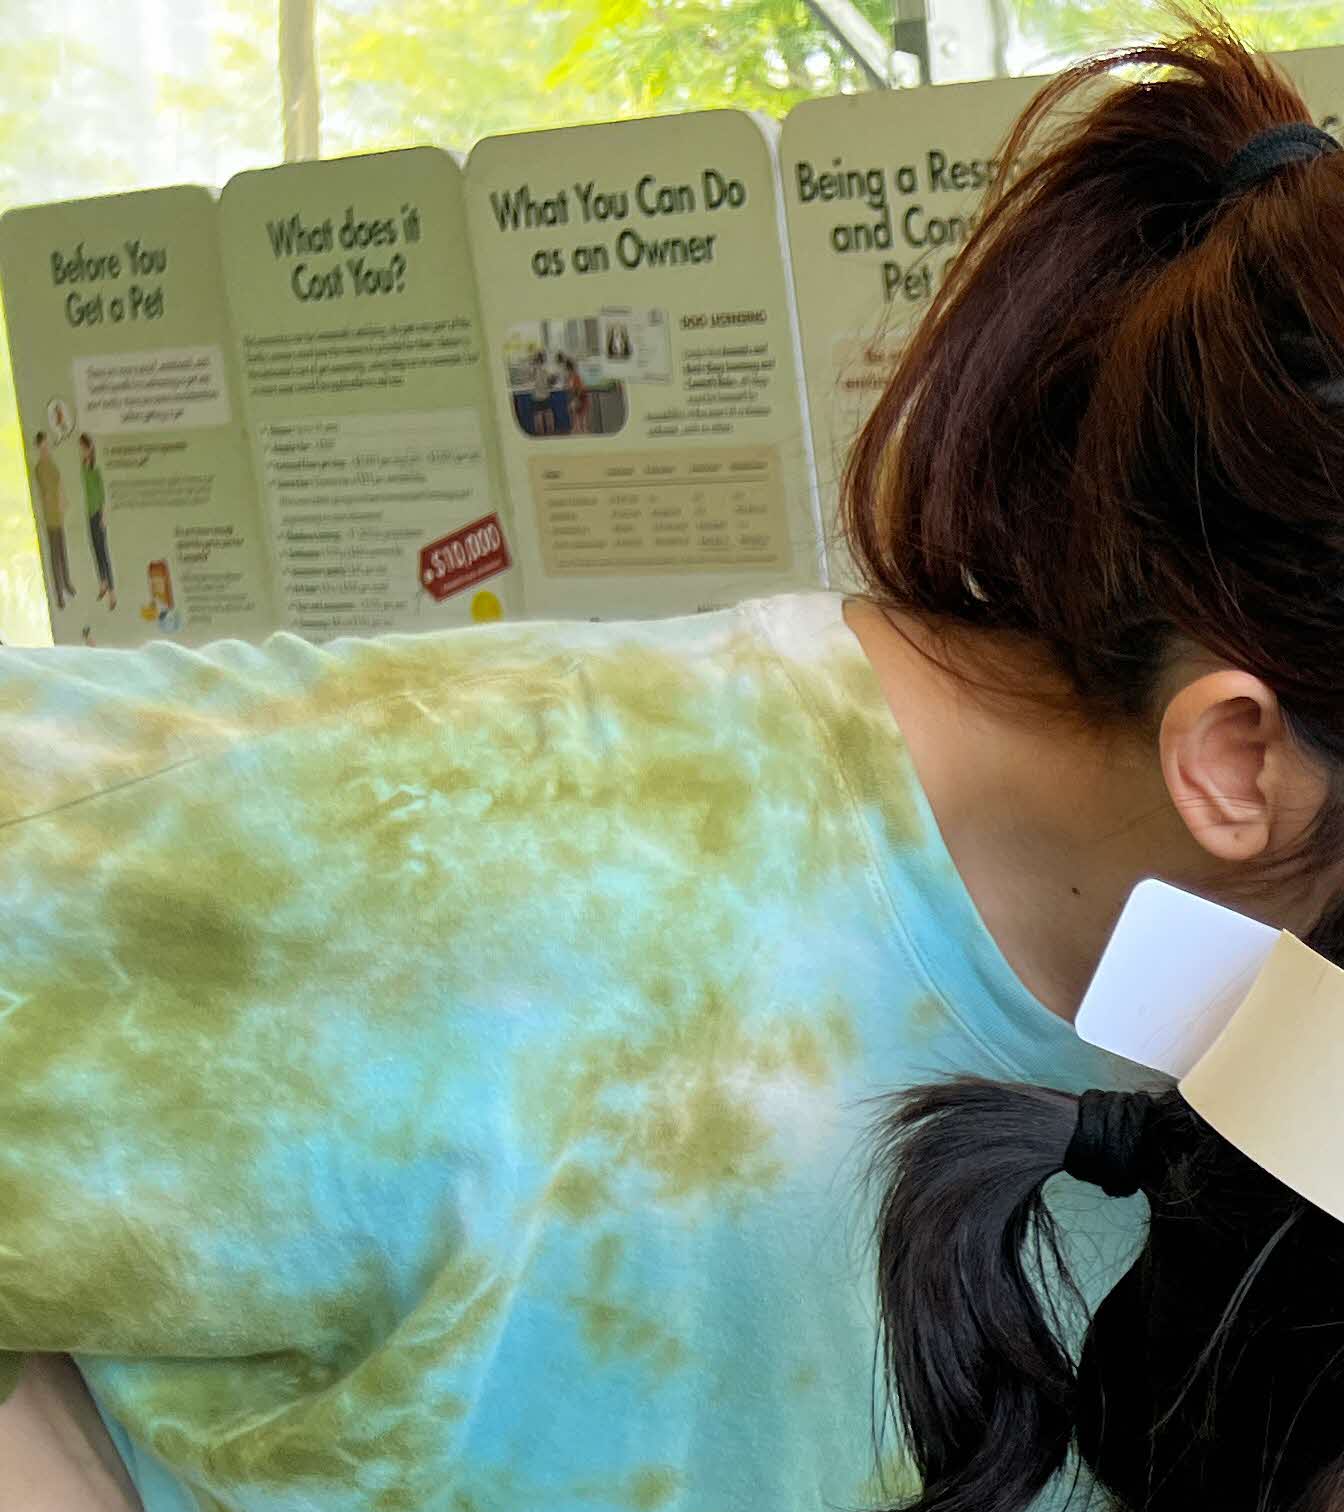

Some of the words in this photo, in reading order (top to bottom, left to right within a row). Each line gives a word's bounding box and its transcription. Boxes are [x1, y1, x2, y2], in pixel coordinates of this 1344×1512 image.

[491, 181, 570, 233] What
[573, 176, 629, 223] You
[633, 173, 695, 217] Can
[701, 167, 747, 210] Do
[796, 157, 888, 211] Being
[895, 165, 917, 194] a
[266, 210, 333, 259] What
[338, 204, 392, 251] does
[400, 203, 421, 244] it
[531, 244, 567, 278] as
[572, 239, 610, 273] an
[614, 225, 716, 271] Owner
[832, 207, 894, 252] and
[50, 244, 121, 285] Before
[126, 239, 168, 275] You
[291, 261, 349, 303] Cost
[352, 254, 408, 297] You?
[883, 261, 933, 304] Pet
[64, 288, 105, 327] Get
[109, 297, 125, 322] a
[129, 284, 165, 322] Pet
